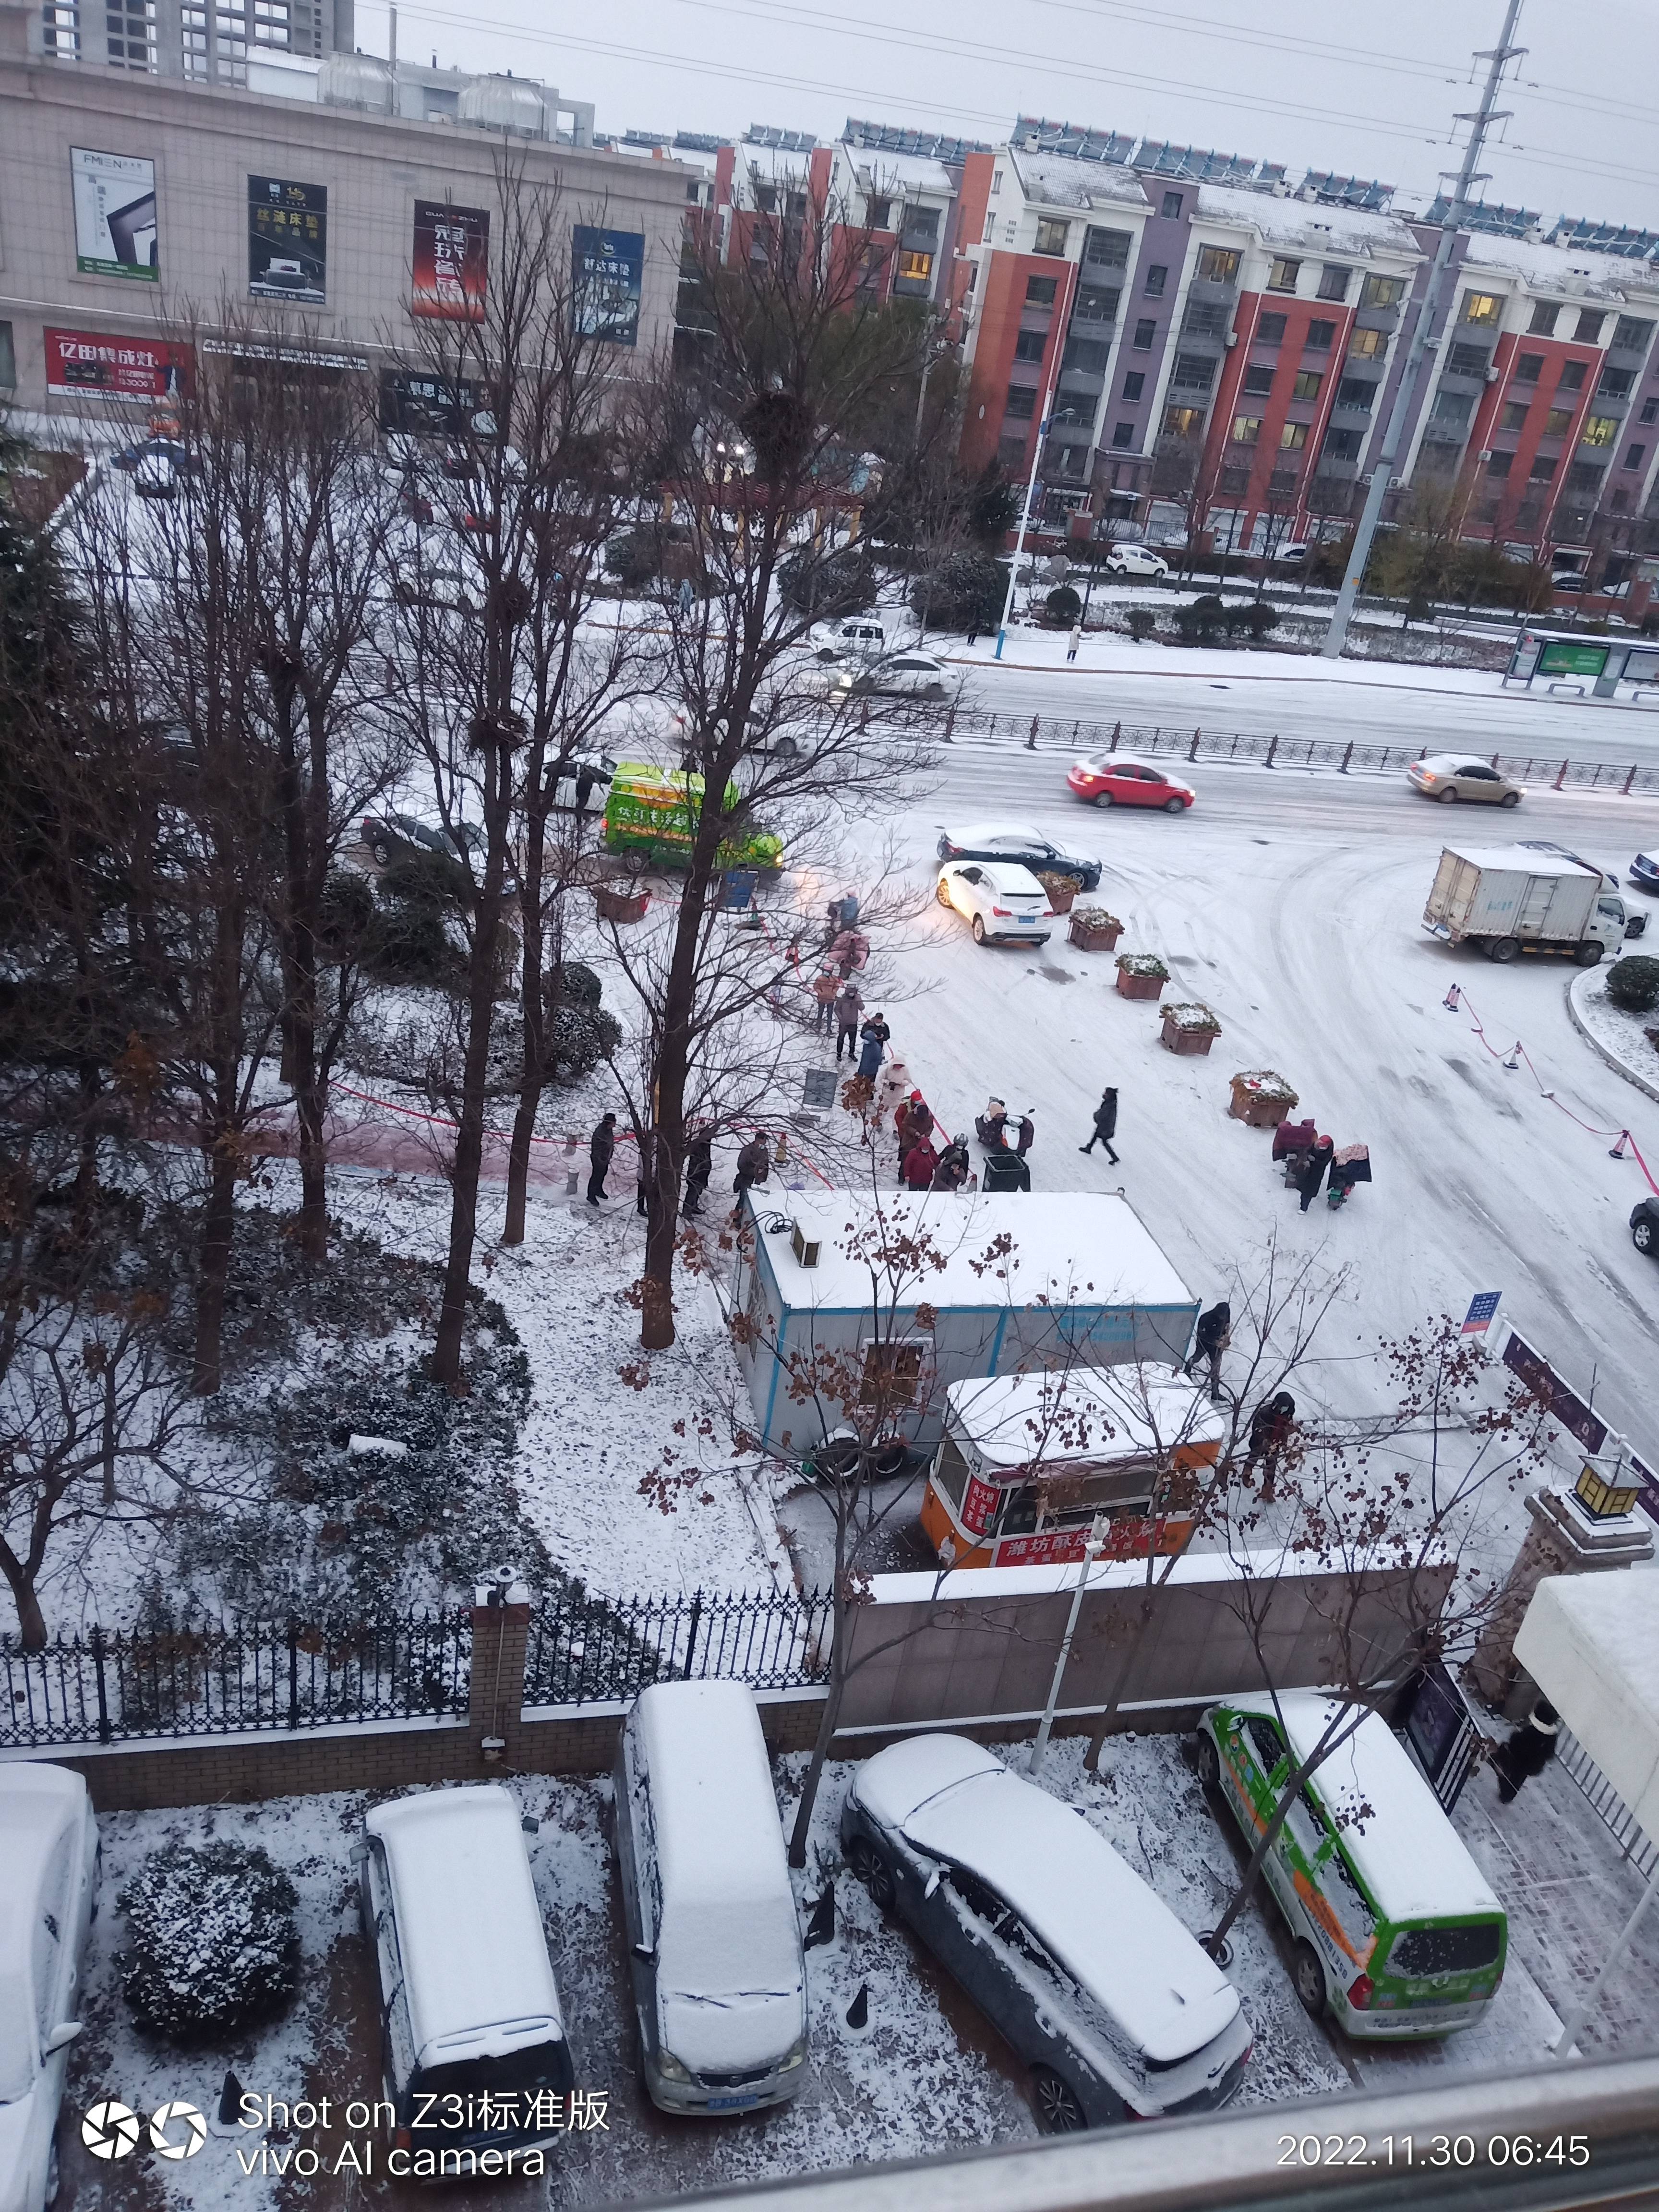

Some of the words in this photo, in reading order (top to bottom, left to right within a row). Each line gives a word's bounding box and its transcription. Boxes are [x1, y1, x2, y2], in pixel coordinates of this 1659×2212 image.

[59, 342, 155, 368] 亿田集成灶
[973, 1484, 995, 1504] 肉火烧
